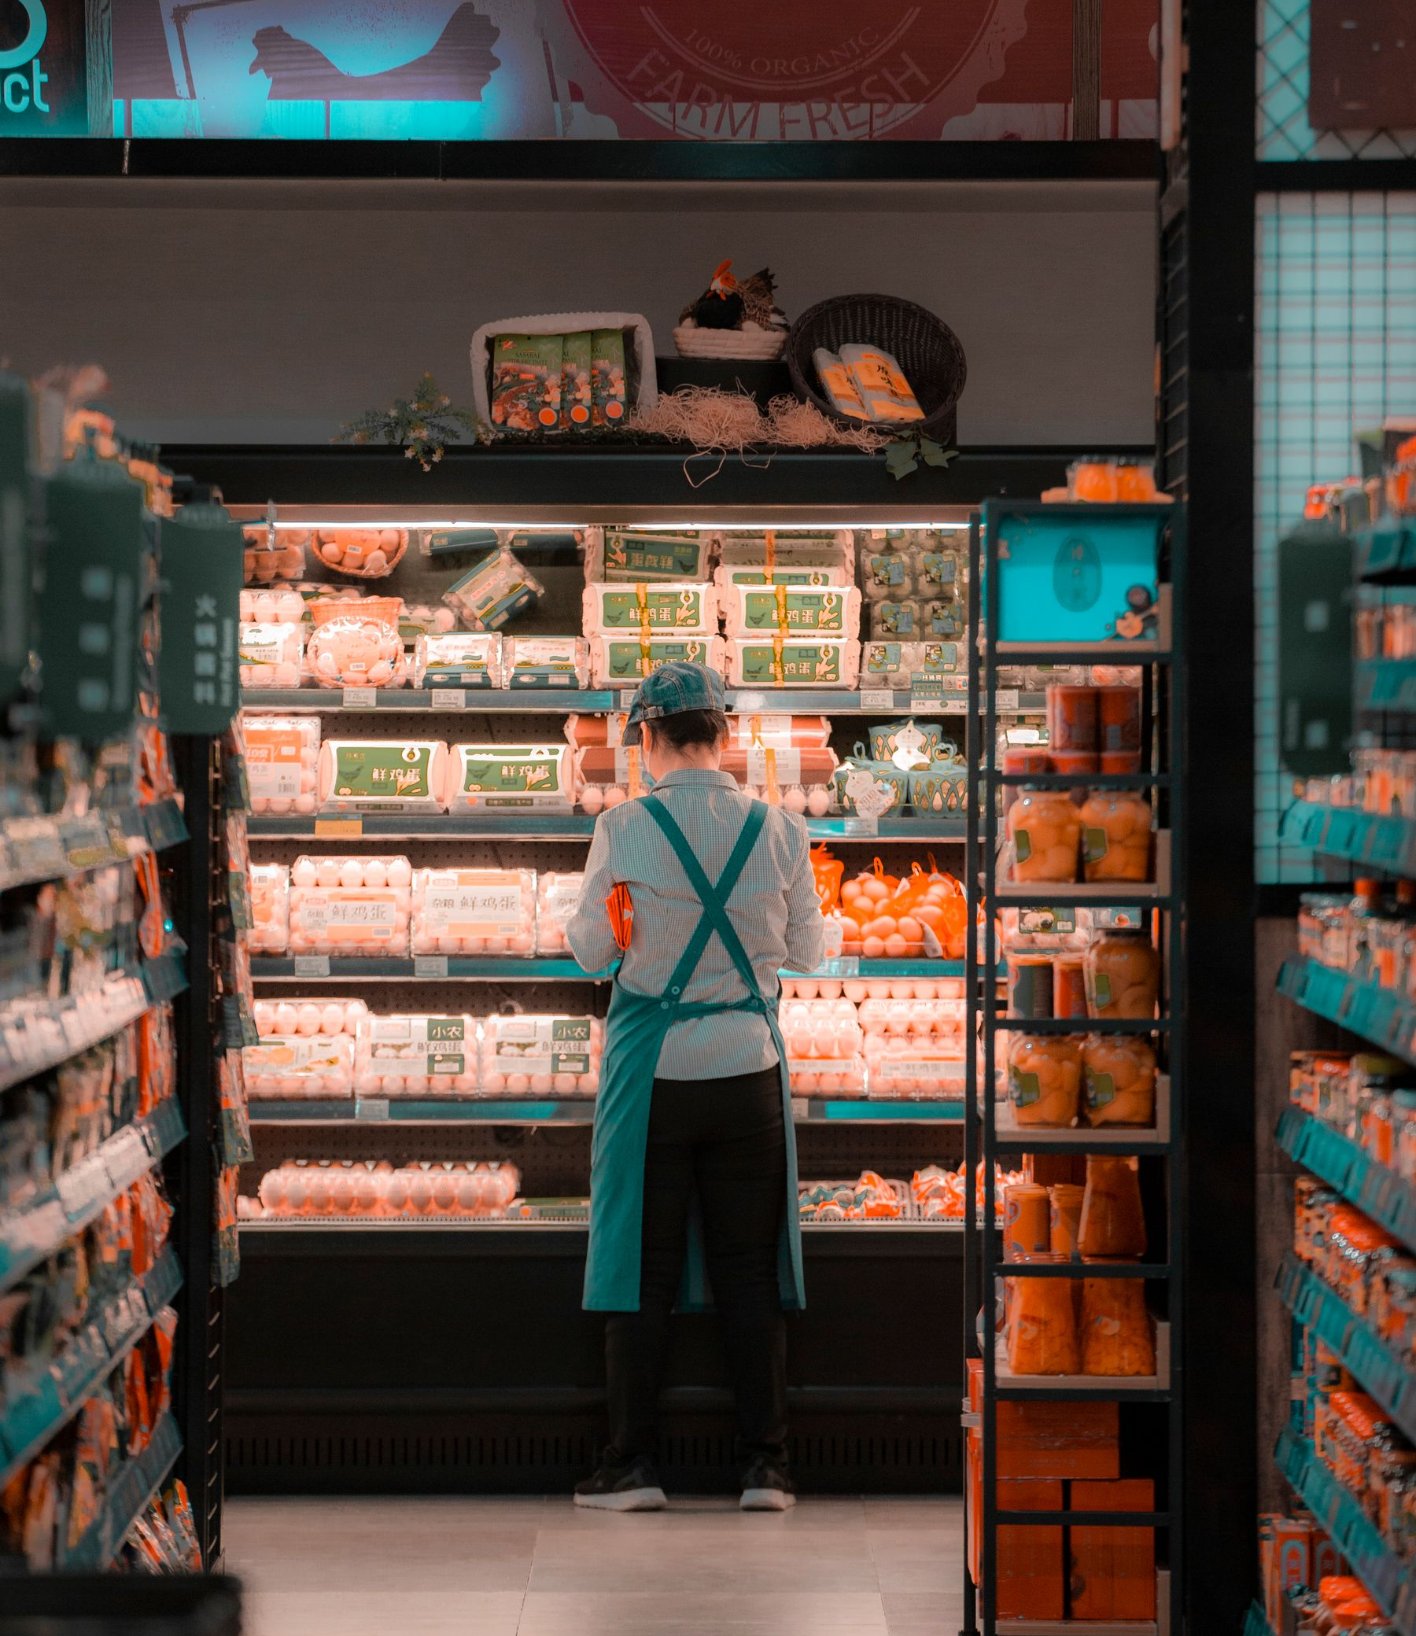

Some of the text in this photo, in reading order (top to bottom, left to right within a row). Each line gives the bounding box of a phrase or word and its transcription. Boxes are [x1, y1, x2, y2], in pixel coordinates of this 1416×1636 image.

[683, 26, 880, 76] 100% ORGANIC
[0, 58, 50, 113] ct
[624, 47, 931, 139] FARM FRESH
[372, 767, 421, 781] 鲜鸡蛋
[501, 764, 551, 778] 鲜鸡蛋
[459, 896, 516, 911] 鲜鸡蛋
[331, 903, 386, 920] 鲜鸡蛋
[431, 1026, 462, 1039] 小农
[556, 1026, 586, 1039] 小农
